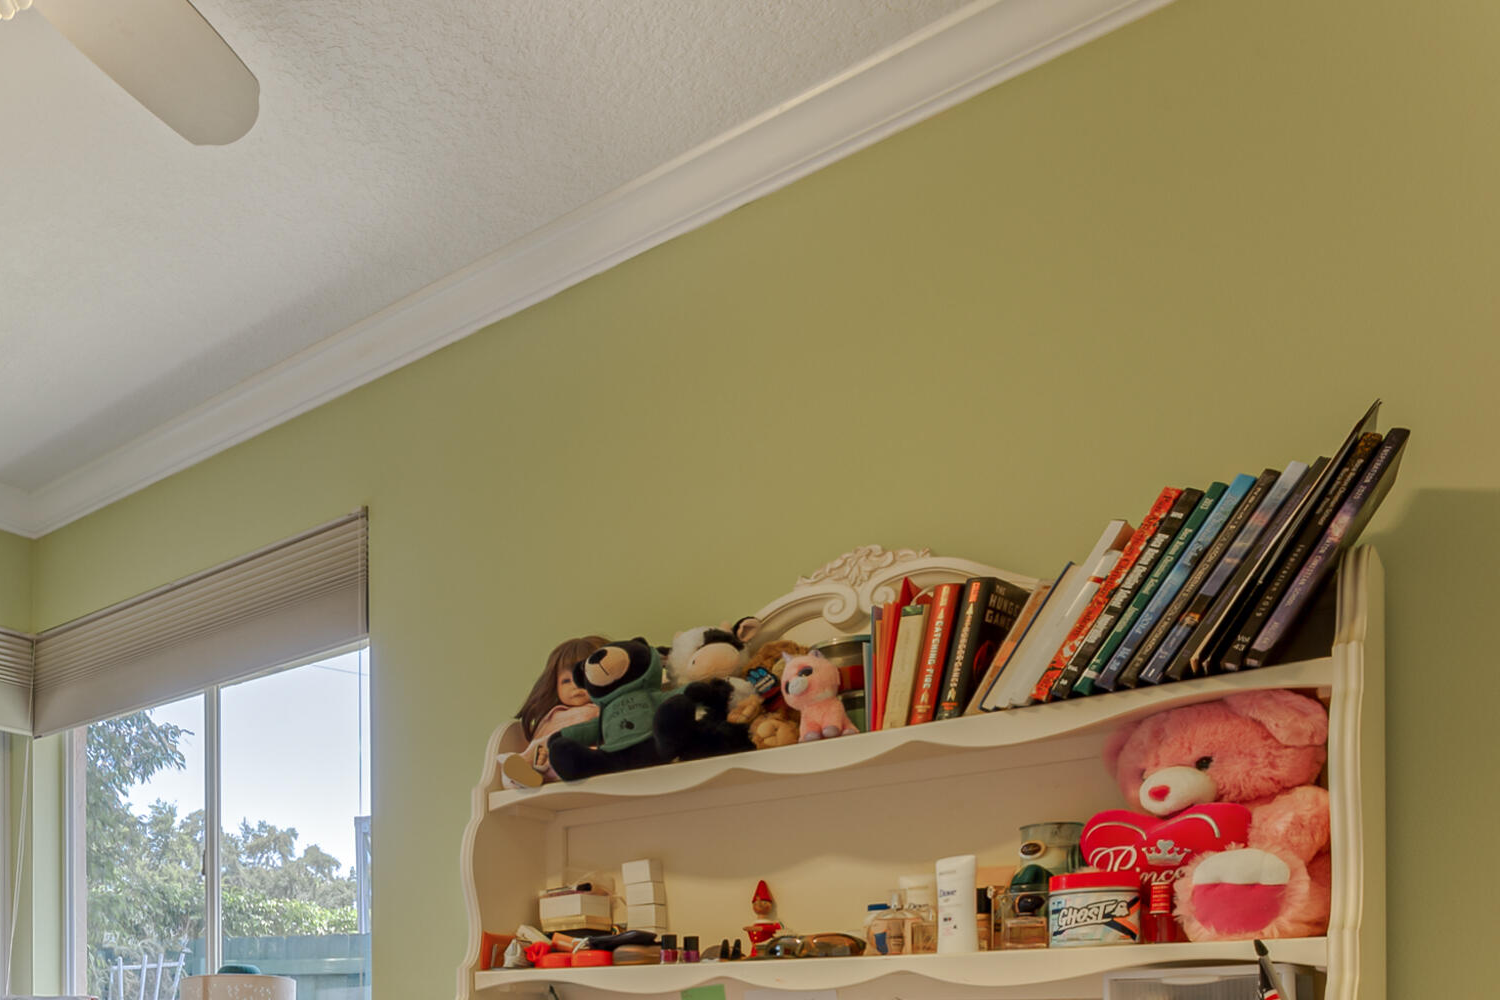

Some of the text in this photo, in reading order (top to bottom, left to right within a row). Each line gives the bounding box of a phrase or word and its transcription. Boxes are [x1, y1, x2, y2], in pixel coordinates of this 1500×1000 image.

[1364, 446, 1391, 482] INSPIRATION
[1183, 543, 1203, 565] School
[984, 608, 1014, 631] GAME
[1136, 613, 1153, 633] 2014
[923, 620, 944, 689] CATCHING FIRE
[1058, 900, 1116, 929] GHOST
